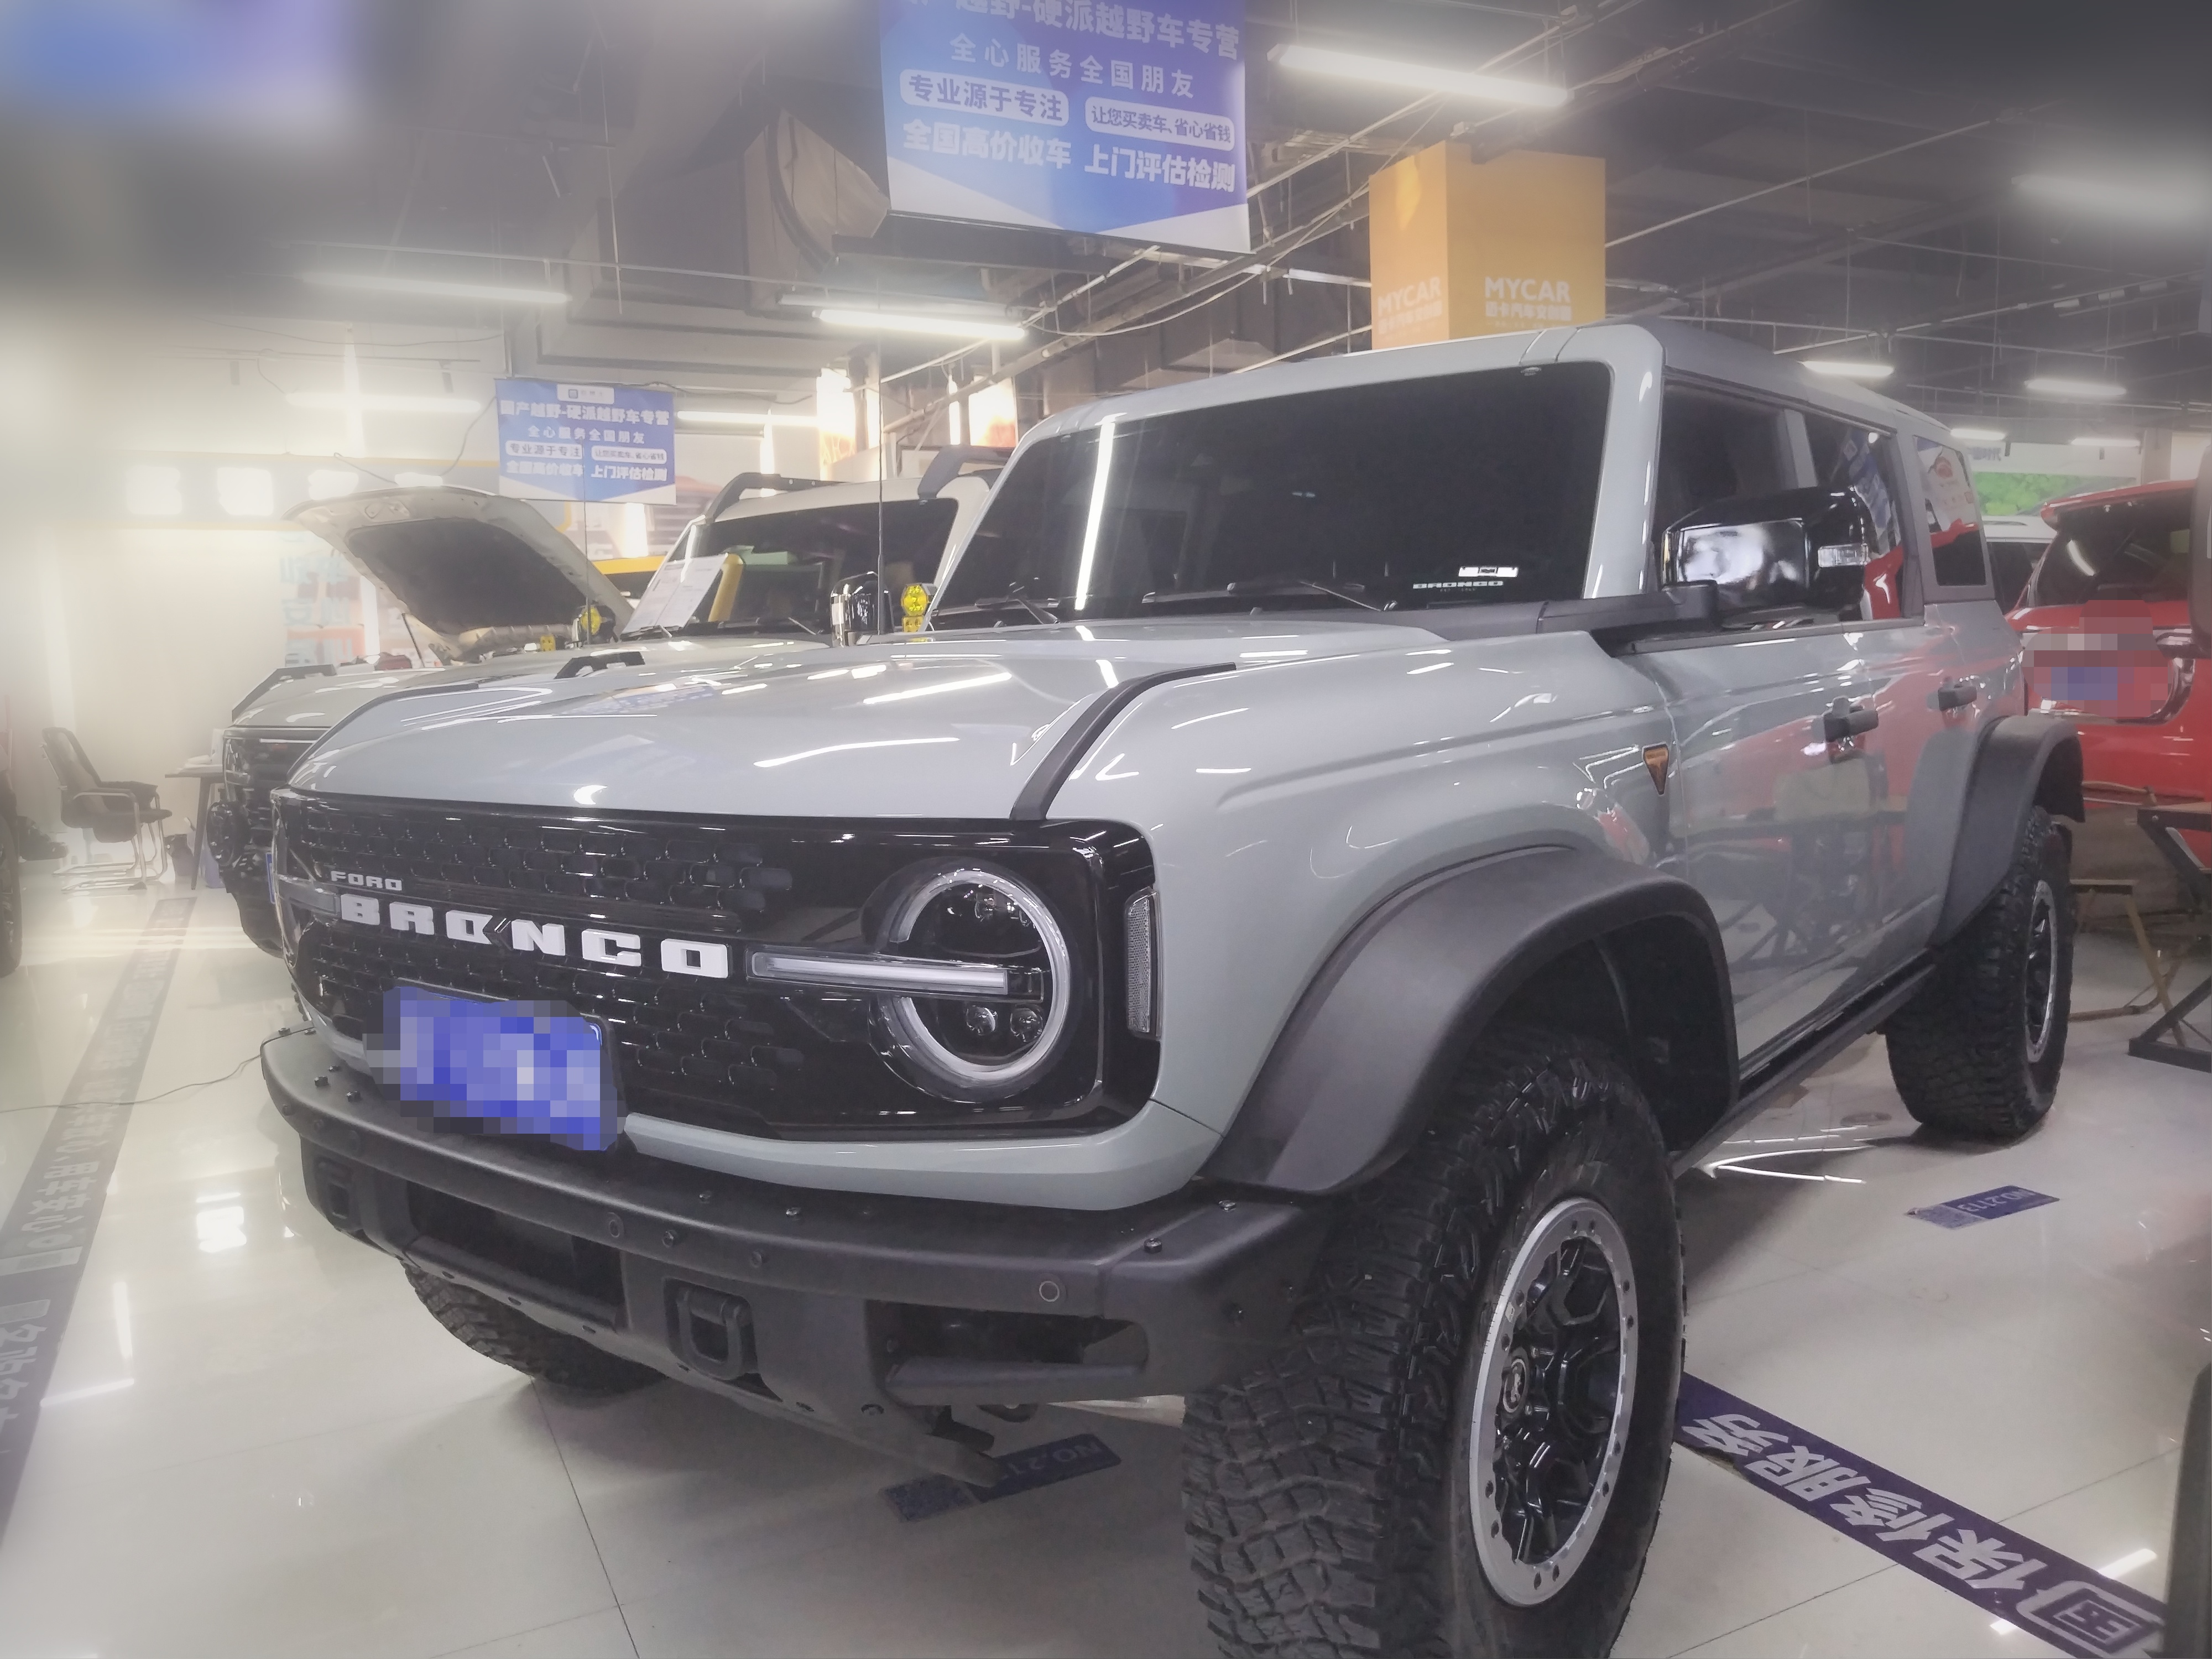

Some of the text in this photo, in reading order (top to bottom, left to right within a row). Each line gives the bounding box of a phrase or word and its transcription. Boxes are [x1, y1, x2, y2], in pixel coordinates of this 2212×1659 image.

[950, 33, 1193, 98] 全心服务全国朋友
[909, 74, 1063, 122] 专业源于专注
[902, 118, 1236, 192] 全国高价收车 上门评估检测
[1378, 276, 1441, 317] MYCAR
[1485, 276, 1572, 303] MYCAR
[331, 870, 403, 891] FORD
[340, 894, 730, 979] BRONCO
